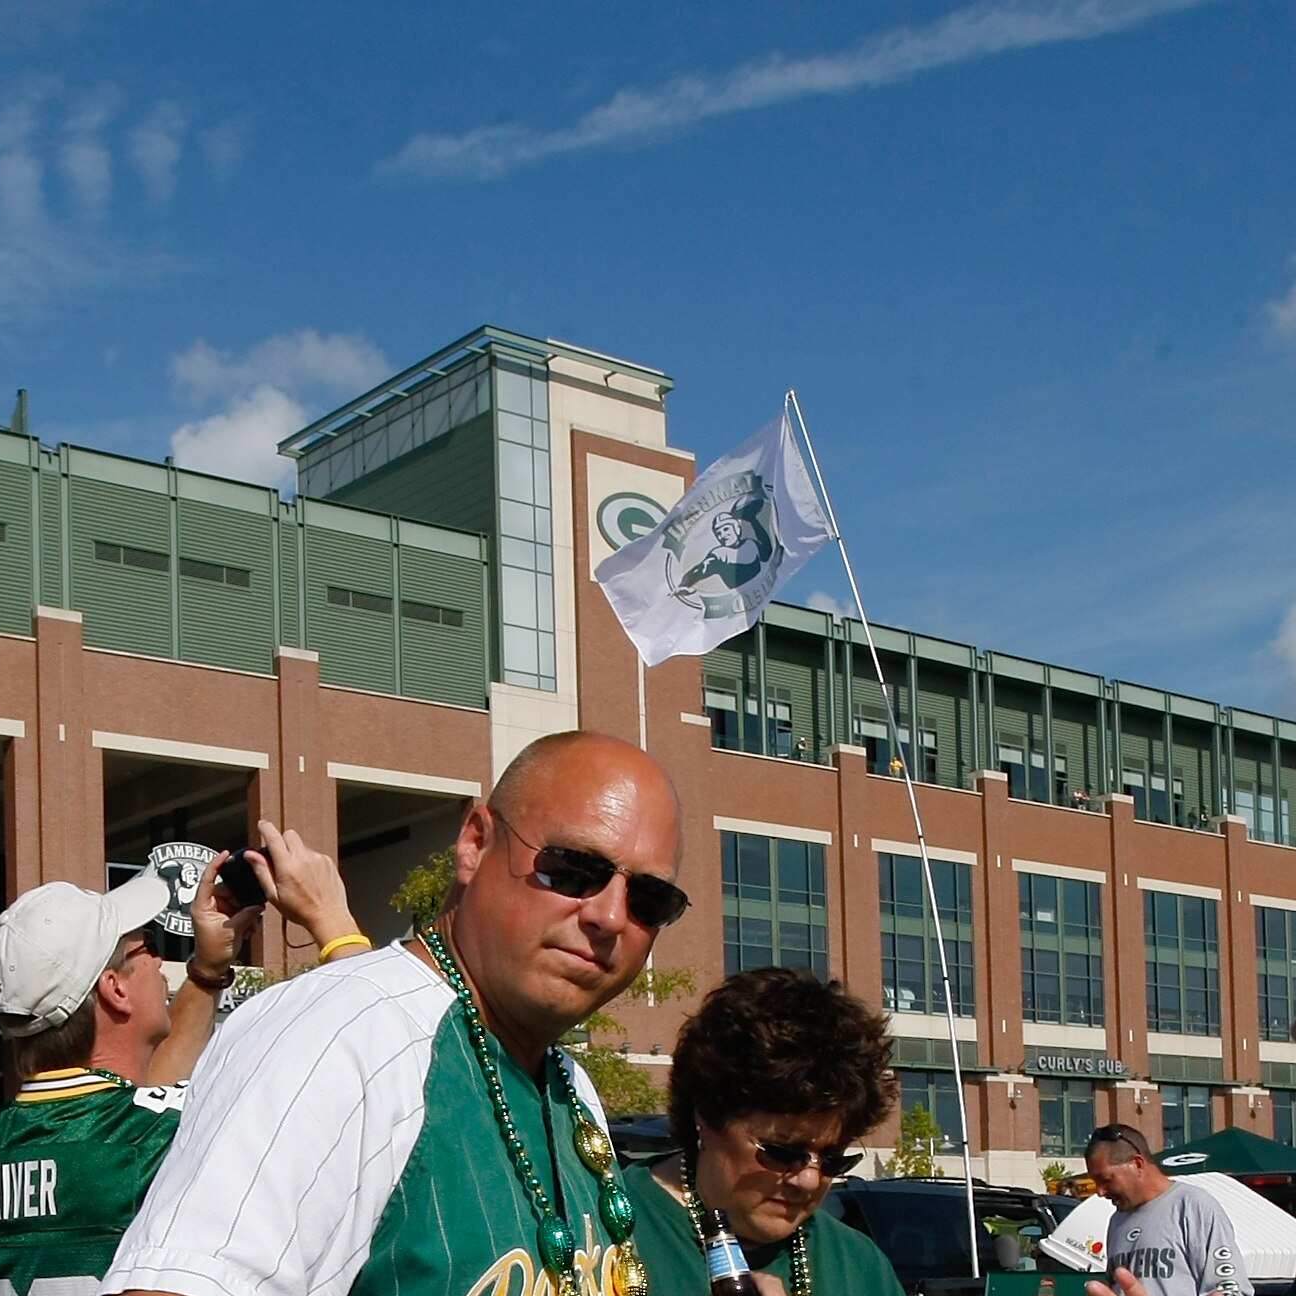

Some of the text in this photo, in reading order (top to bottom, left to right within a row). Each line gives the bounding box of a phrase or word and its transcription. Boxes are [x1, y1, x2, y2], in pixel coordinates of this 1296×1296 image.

[170, 918, 195, 934] FIE
[1038, 1056, 1123, 1074] CURLY'S PUB
[1127, 1228, 1143, 1242] G
